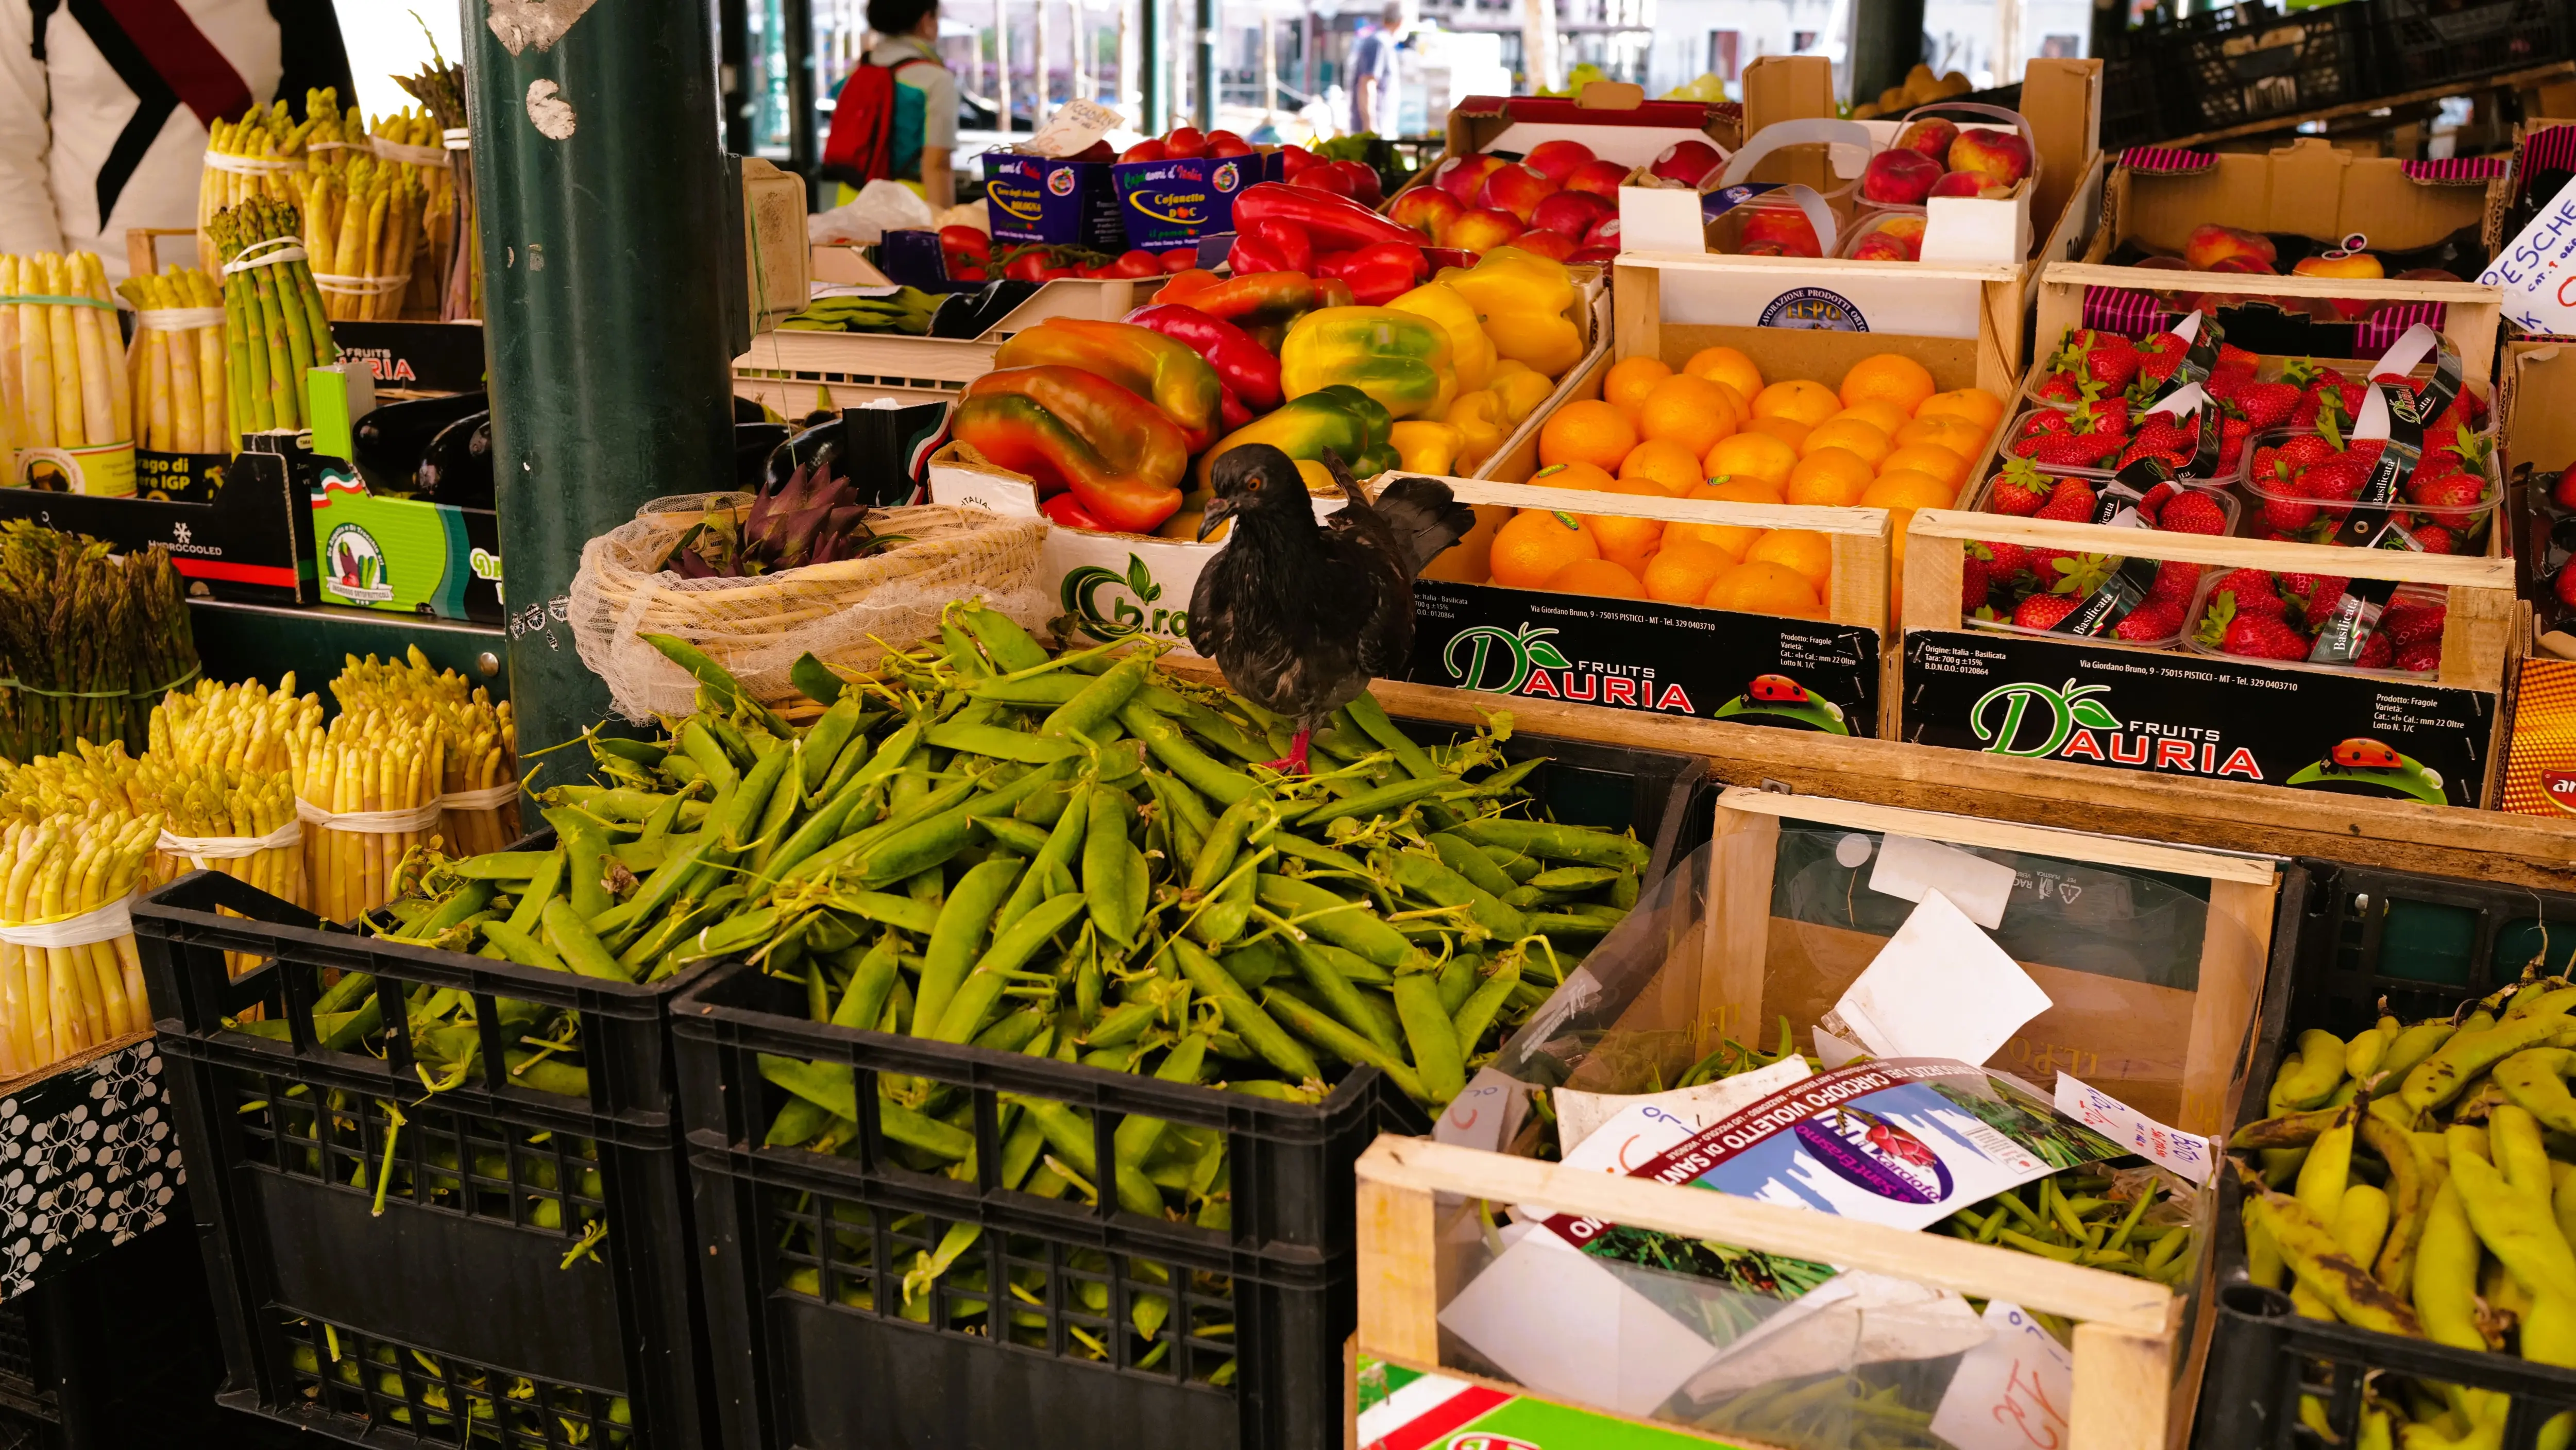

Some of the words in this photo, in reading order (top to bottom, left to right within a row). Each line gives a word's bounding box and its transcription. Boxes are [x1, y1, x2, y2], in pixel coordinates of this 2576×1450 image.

[1155, 193, 1205, 206] Cofanetto
[2481, 199, 2576, 286] PESCHE
[1808, 289, 1851, 313] PRODOTTI
[346, 348, 391, 358] FRUITS
[172, 457, 189, 473] di
[161, 474, 191, 490] IGP
[2373, 459, 2395, 505] Basilicata
[1442, 596, 1468, 605] Basilicata
[1531, 605, 1540, 613] Via
[1541, 606, 1568, 616] Giordano
[1569, 608, 1589, 618] Bruno,
[1600, 611, 1618, 620] 75015
[1620, 613, 1643, 623] PISTICCI
[1664, 618, 1674, 627] Tel.
[1688, 621, 1715, 631] 0403710
[2072, 593, 2114, 635] Basilicata
[2333, 599, 2360, 651] Basilicata
[1781, 633, 1808, 642] Prodotto:
[1809, 636, 1832, 645] Fragole
[1781, 641, 1803, 650] Varietà:
[1805, 653, 1818, 661] Cal.:
[1841, 657, 1856, 666] Oltre
[1925, 645, 1951, 654] Origine:
[1953, 647, 1969, 656] Italia
[1975, 650, 2006, 660] Basilicata
[1578, 660, 1655, 678] FRUITS
[1925, 662, 1958, 672] B.D.N.O.O.:
[1960, 667, 1989, 675] 0120864
[2080, 659, 2091, 668] Via
[2092, 661, 2124, 672] Giordano
[2125, 664, 2147, 675] Bruno,
[2161, 669, 2183, 678] 75015
[2184, 670, 2212, 681] PISTICCI
[2236, 676, 2248, 686] Tel.
[2250, 678, 2264, 687] 329
[2265, 680, 2298, 691] 0403710
[2375, 703, 2402, 712] Varietà:
[2376, 693, 2410, 704] Prodotto:
[2411, 697, 2437, 707] Fragole
[2373, 722, 2392, 730] Lotto
[2374, 712, 2389, 721] Cat.:
[2403, 715, 2418, 724] Cal.:
[2447, 720, 2465, 728] Oltre
[2129, 721, 2221, 742] FRUITS
[2036, 871, 2060, 880] PLASTICA
[1881, 1068, 1909, 1079] DEL
[1789, 1073, 1835, 1096] SANT'ERASMO
[1805, 1072, 1890, 1106] CARCIOFO
[1747, 1094, 1788, 1117] MAZZORBO
[1701, 1121, 1734, 1141] PICCOLO
[1722, 1101, 1814, 1149] VIOLETTO
[1665, 1140, 1701, 1161] VIGNOLE
[1702, 1142, 1726, 1158] DI
[1795, 1124, 1897, 1196] Sant'Erasmo
[1876, 1155, 1941, 1201] carciofo
